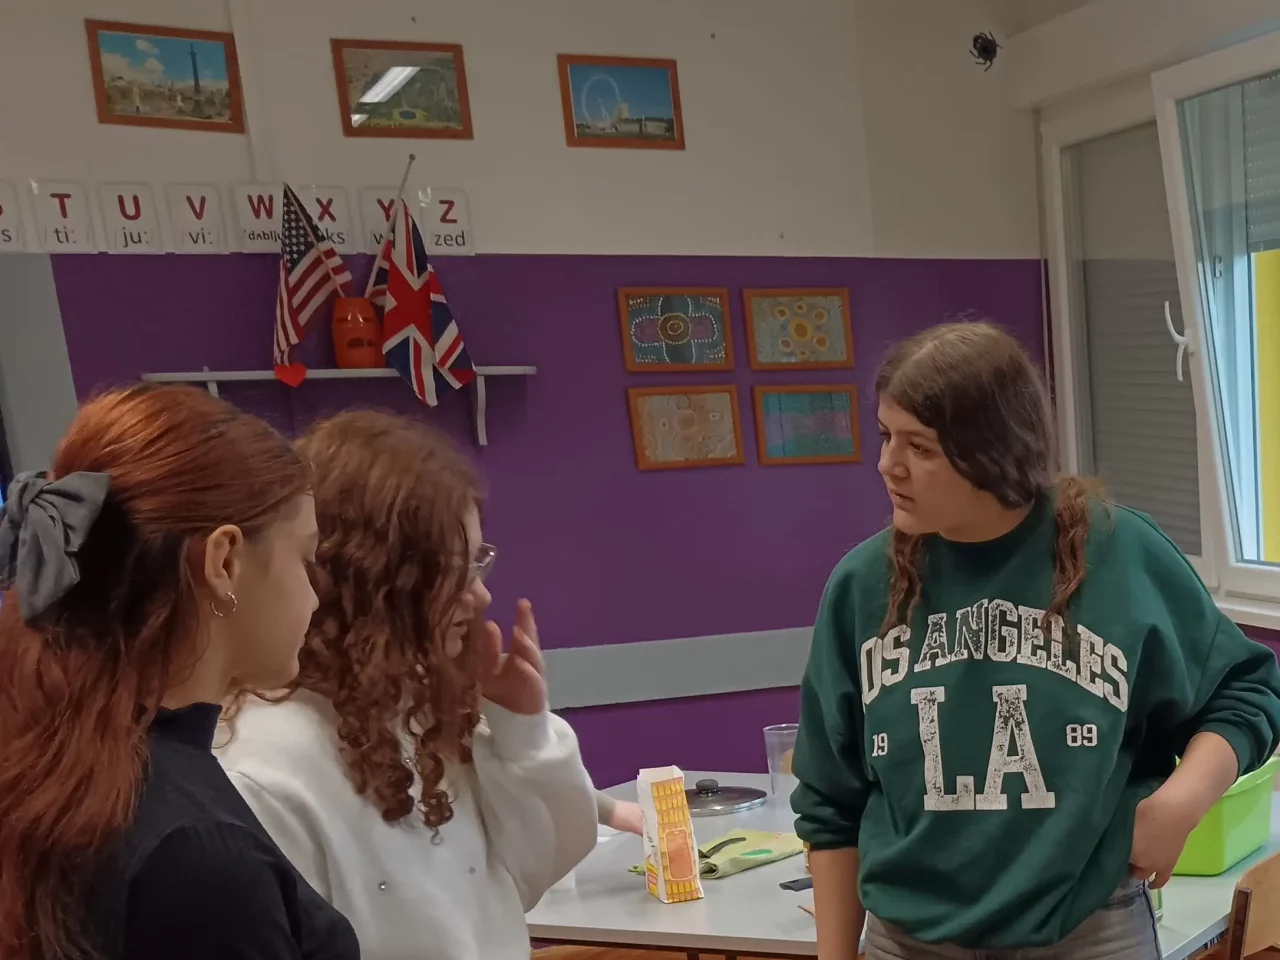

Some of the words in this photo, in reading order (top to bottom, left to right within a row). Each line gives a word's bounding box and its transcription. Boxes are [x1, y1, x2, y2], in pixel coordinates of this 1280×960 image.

[50, 193, 71, 219] T
[118, 194, 141, 221] U
[186, 195, 206, 221] V
[247, 194, 274, 220] W
[316, 197, 336, 223] X
[376, 198, 395, 222] Y
[438, 200, 458, 224] Z
[0, 229, 12, 243] s
[325, 228, 345, 244] ks
[434, 230, 466, 247] zed
[860, 624, 911, 714] OS
[914, 599, 1128, 712] ANGELES
[871, 733, 888, 757] 19
[911, 684, 1055, 811] LA
[1066, 724, 1098, 747] 89
